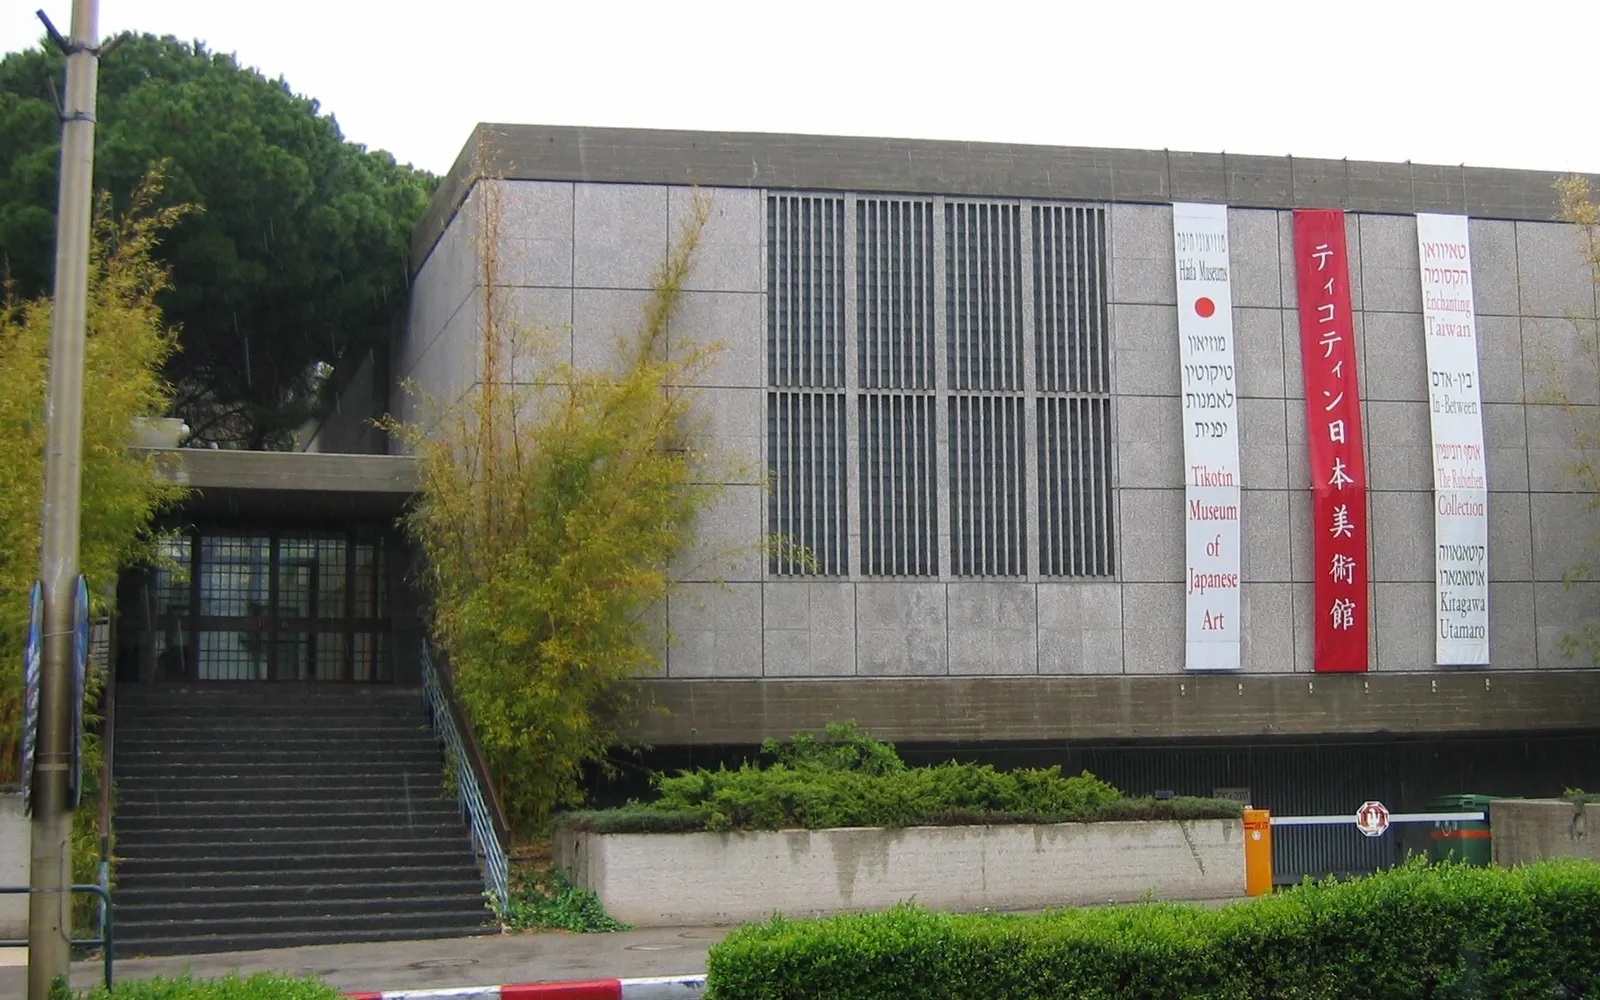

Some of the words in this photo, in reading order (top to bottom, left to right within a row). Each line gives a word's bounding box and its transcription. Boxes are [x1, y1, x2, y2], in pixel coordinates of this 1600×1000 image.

[1424, 267, 1469, 288] הקסומה
[1425, 290, 1471, 318] Enchanting
[1426, 316, 1472, 338] Taiwan
[1188, 335, 1226, 356] מוזיאון
[1185, 364, 1233, 387] טיקוטין
[1186, 388, 1234, 409] לאמנות
[1195, 421, 1228, 438] יפנית
[1311, 243, 1357, 631] ティコティン日本美術館
[1191, 465, 1234, 487] Tikotin
[1438, 468, 1451, 488] The
[1189, 500, 1238, 521] Museum
[1438, 494, 1484, 516] Collection
[1206, 534, 1221, 557] of
[1188, 567, 1238, 595] Japanese
[1440, 591, 1486, 618] Kitagawa
[1201, 609, 1225, 630] Art
[1440, 618, 1486, 639] Utamaro
